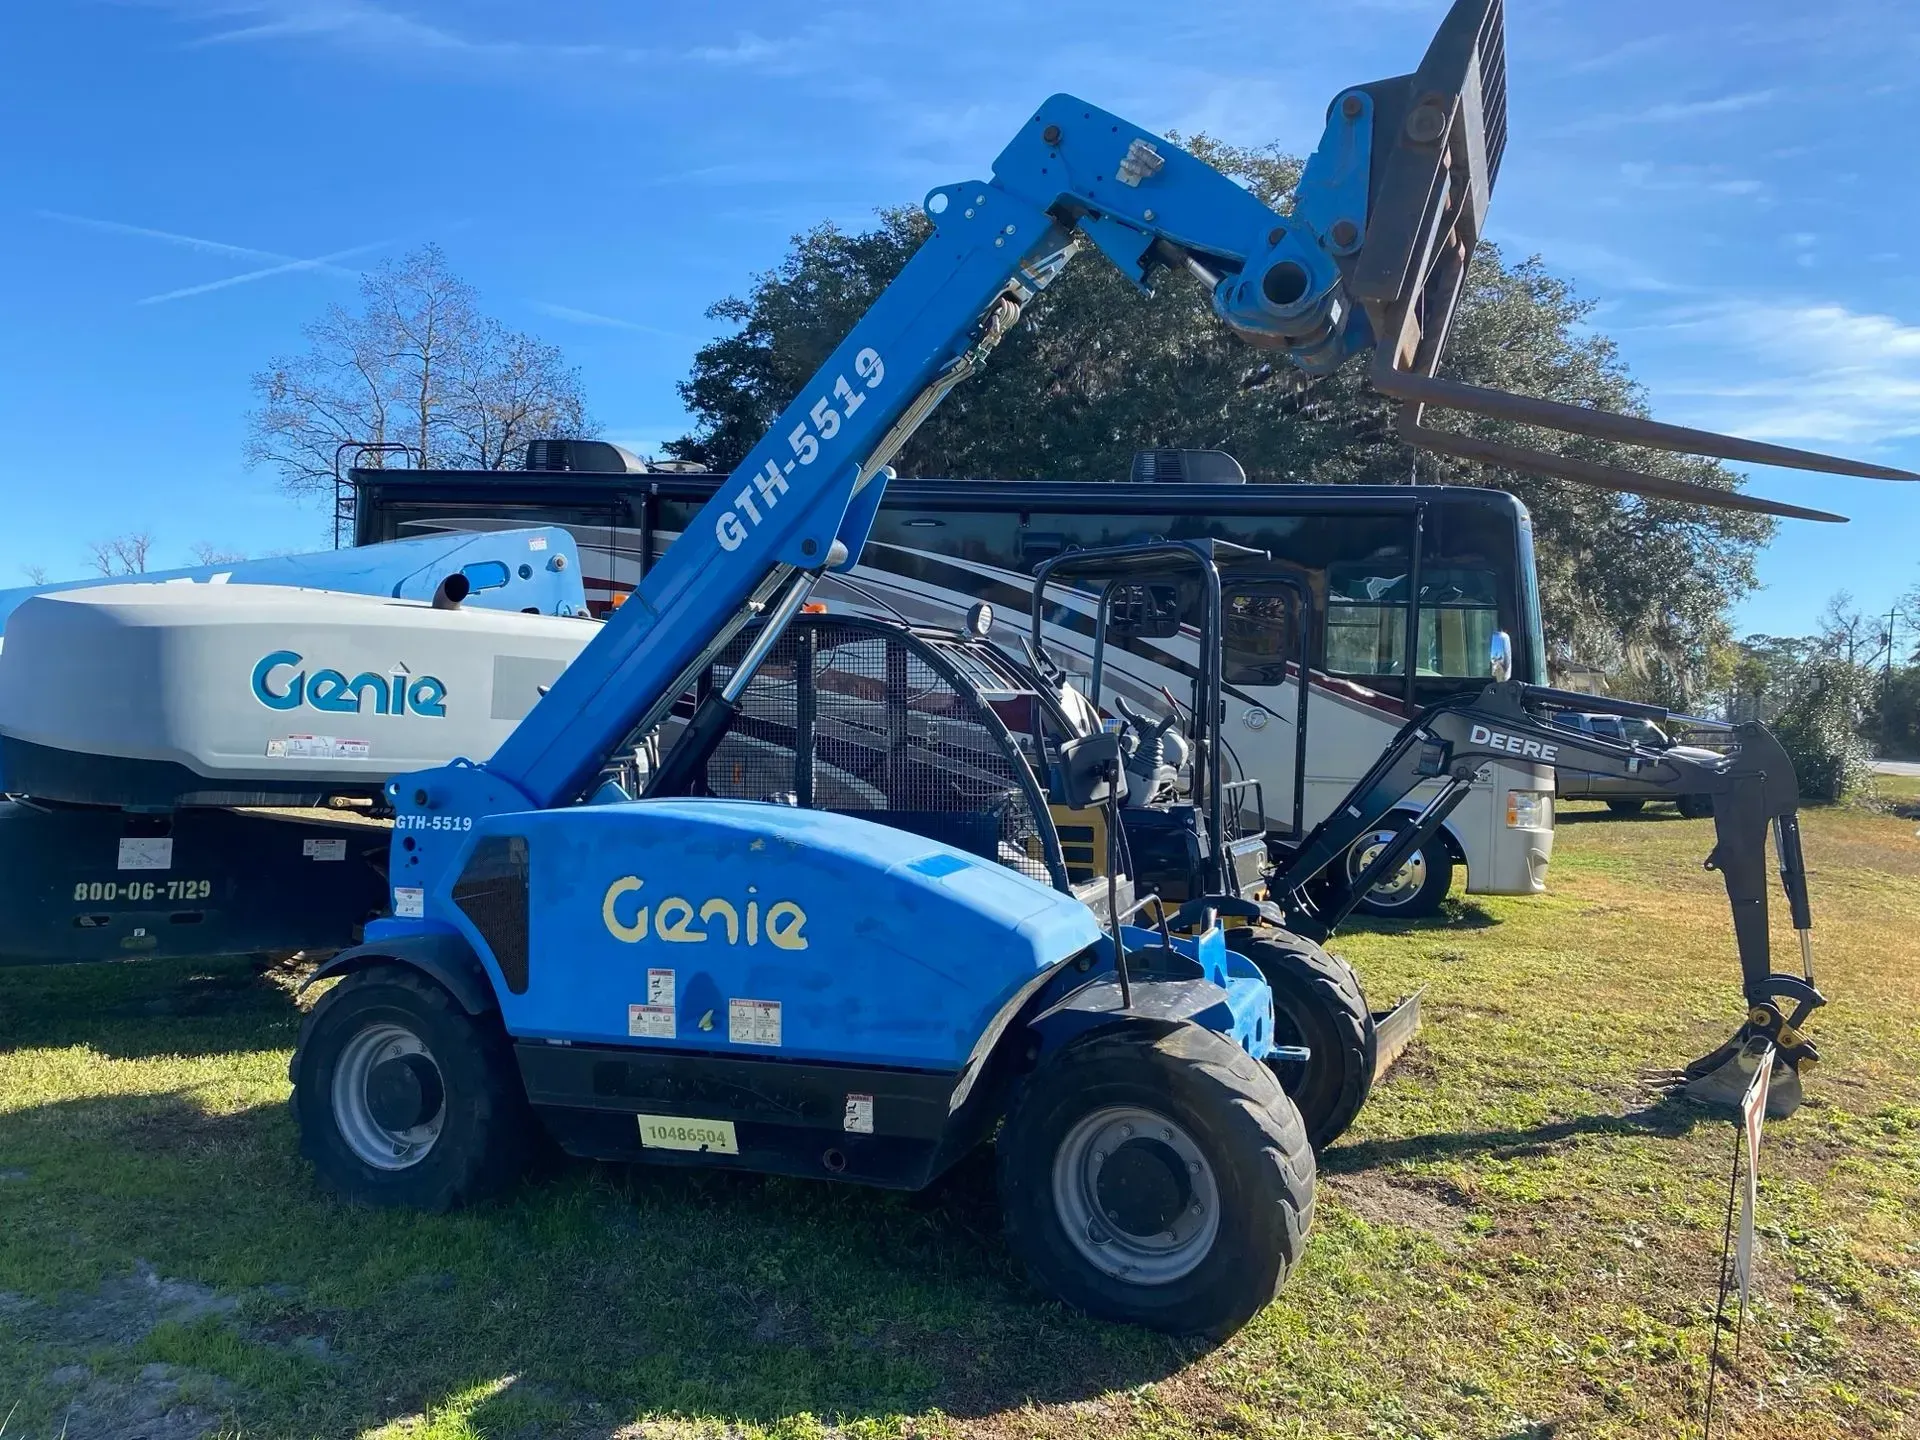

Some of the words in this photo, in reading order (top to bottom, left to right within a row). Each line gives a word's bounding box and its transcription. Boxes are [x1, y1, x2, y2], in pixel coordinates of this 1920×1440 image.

[715, 347, 886, 552] GTH-5519
[252, 650, 447, 718] Genie
[1471, 725, 1559, 761] DEERE
[395, 815, 472, 831] GTH-5519
[74, 880, 211, 901] 800-06-7129
[602, 875, 810, 951] Genie
[649, 1126, 726, 1145] 10486504
